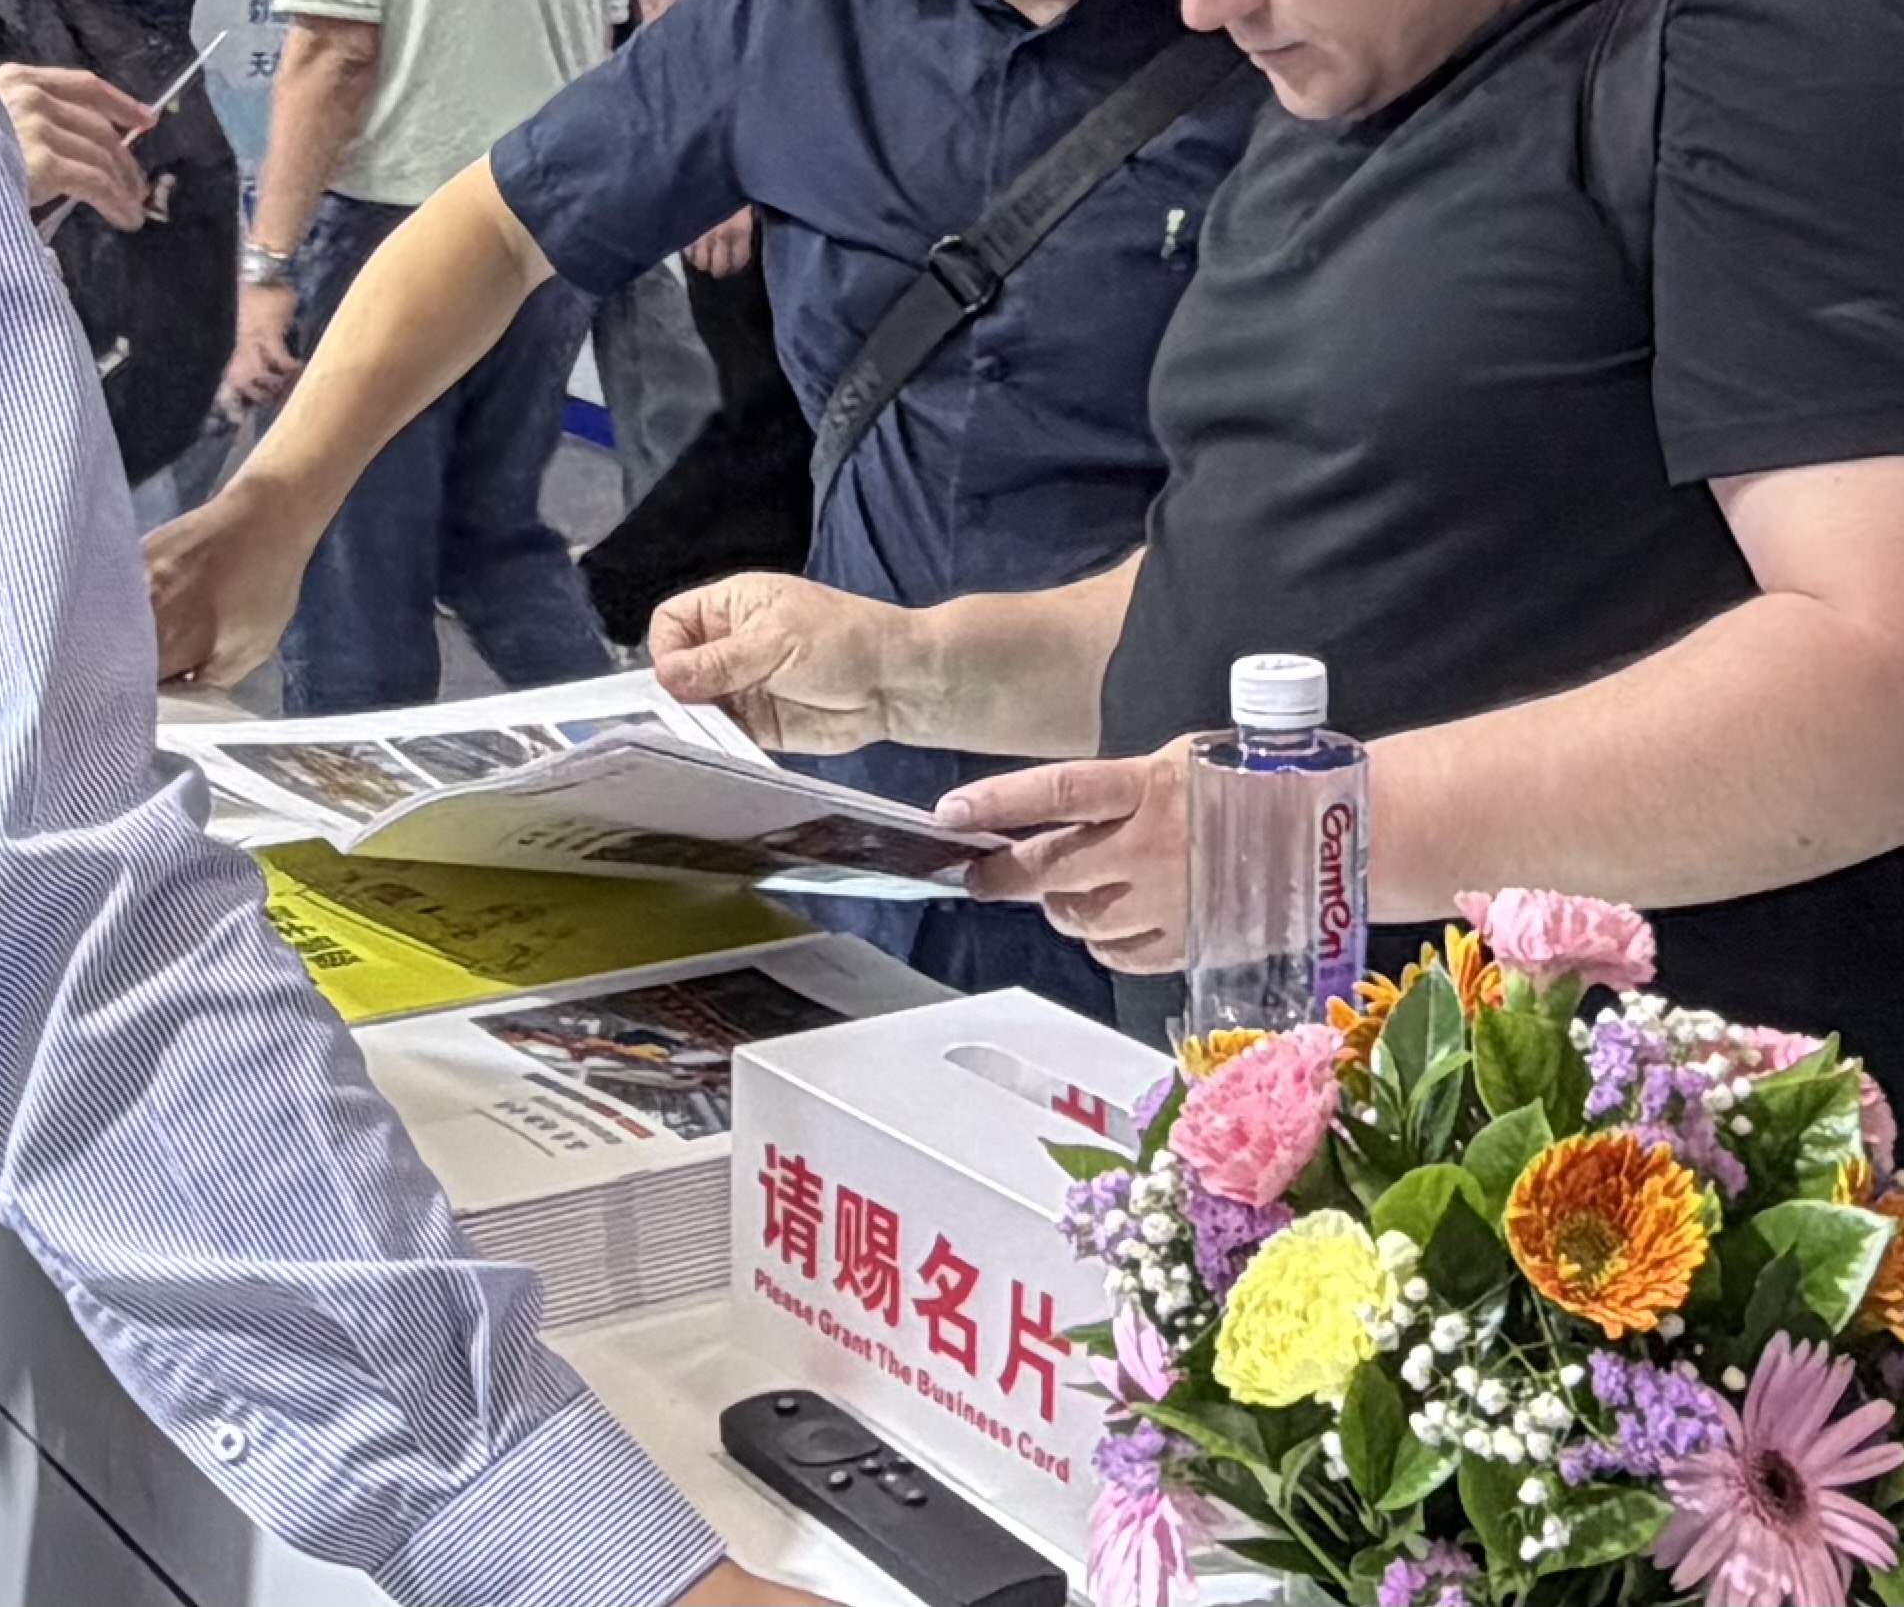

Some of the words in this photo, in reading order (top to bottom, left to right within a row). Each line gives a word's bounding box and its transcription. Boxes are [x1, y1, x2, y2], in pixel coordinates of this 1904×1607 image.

[754, 1268, 813, 1327] Please
[818, 1308, 872, 1362] Grant
[876, 1341, 912, 1386] The
[916, 1368, 1012, 1448] Business
[1017, 1431, 1069, 1484] Card
[759, 1143, 1072, 1423] 请赐名片
